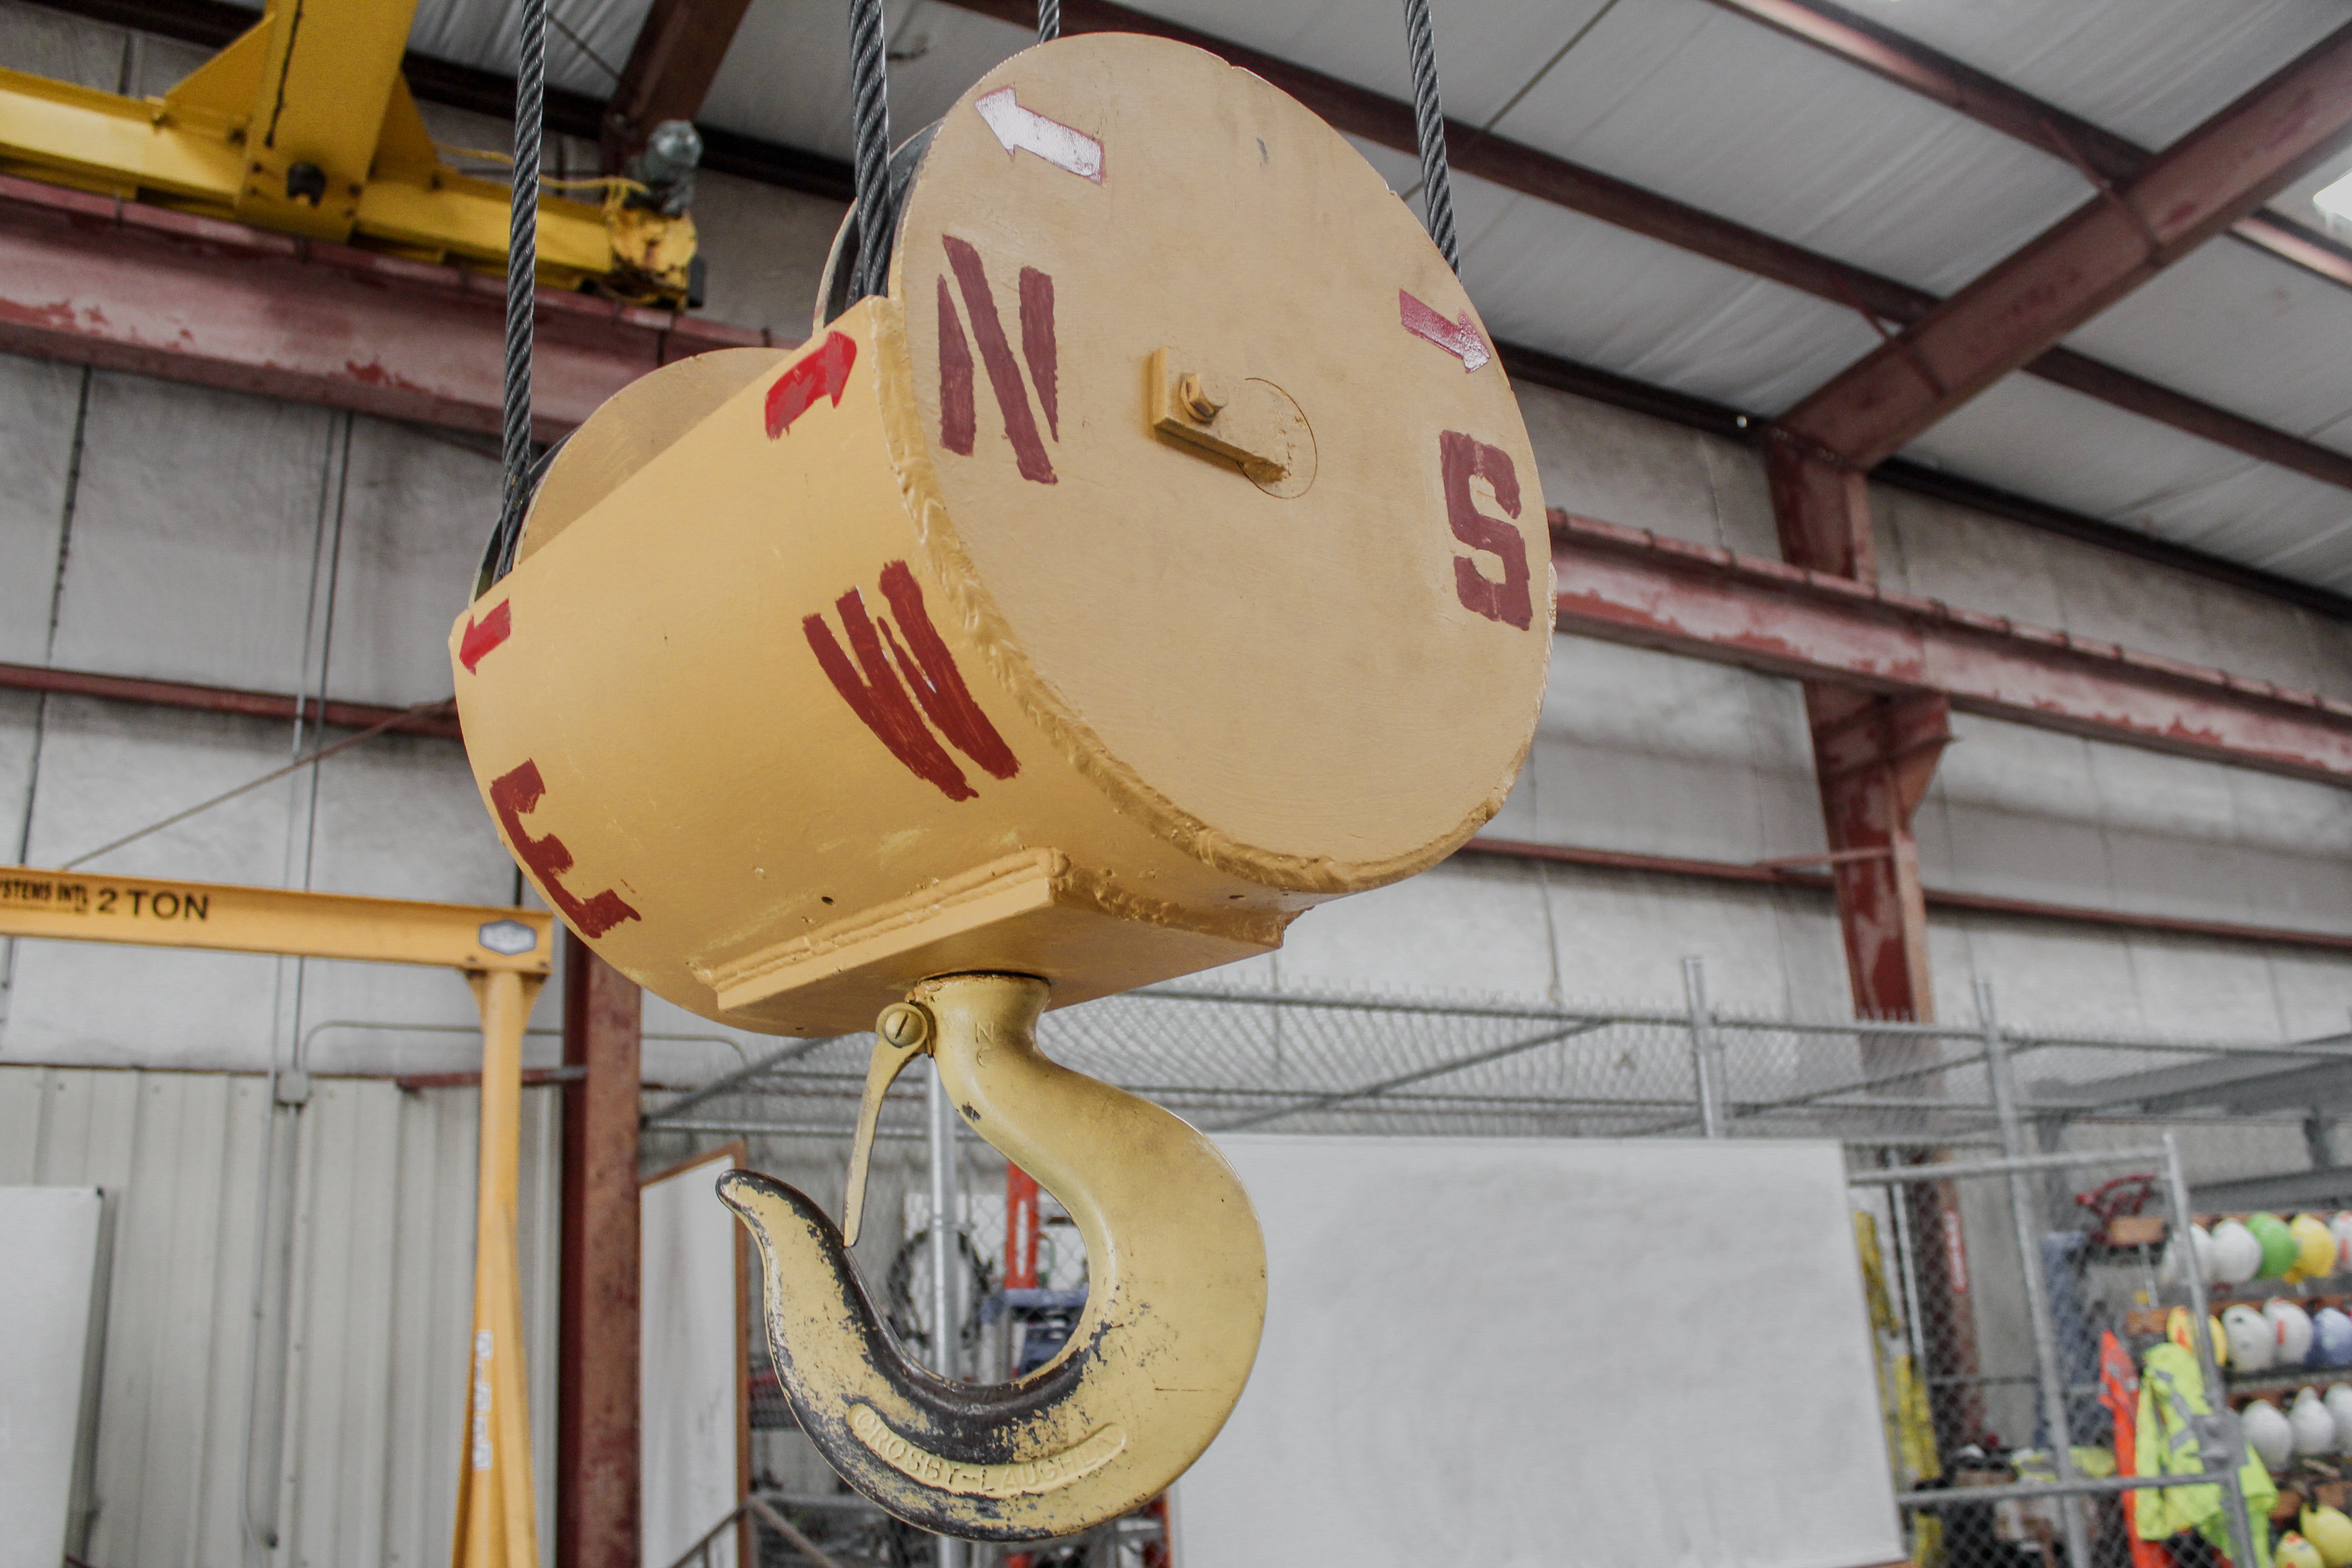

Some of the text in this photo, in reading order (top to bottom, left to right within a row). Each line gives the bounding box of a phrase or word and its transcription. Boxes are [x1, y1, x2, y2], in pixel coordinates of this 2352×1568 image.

[937, 234, 1059, 484] N
[1439, 429, 1534, 631] S
[802, 559, 1021, 802] W
[0, 878, 52, 901] STEMS
[97, 887, 208, 921] 2 TON
[489, 758, 641, 939] E
[853, 1411, 1122, 1493] CROSBY-LAUGHL
